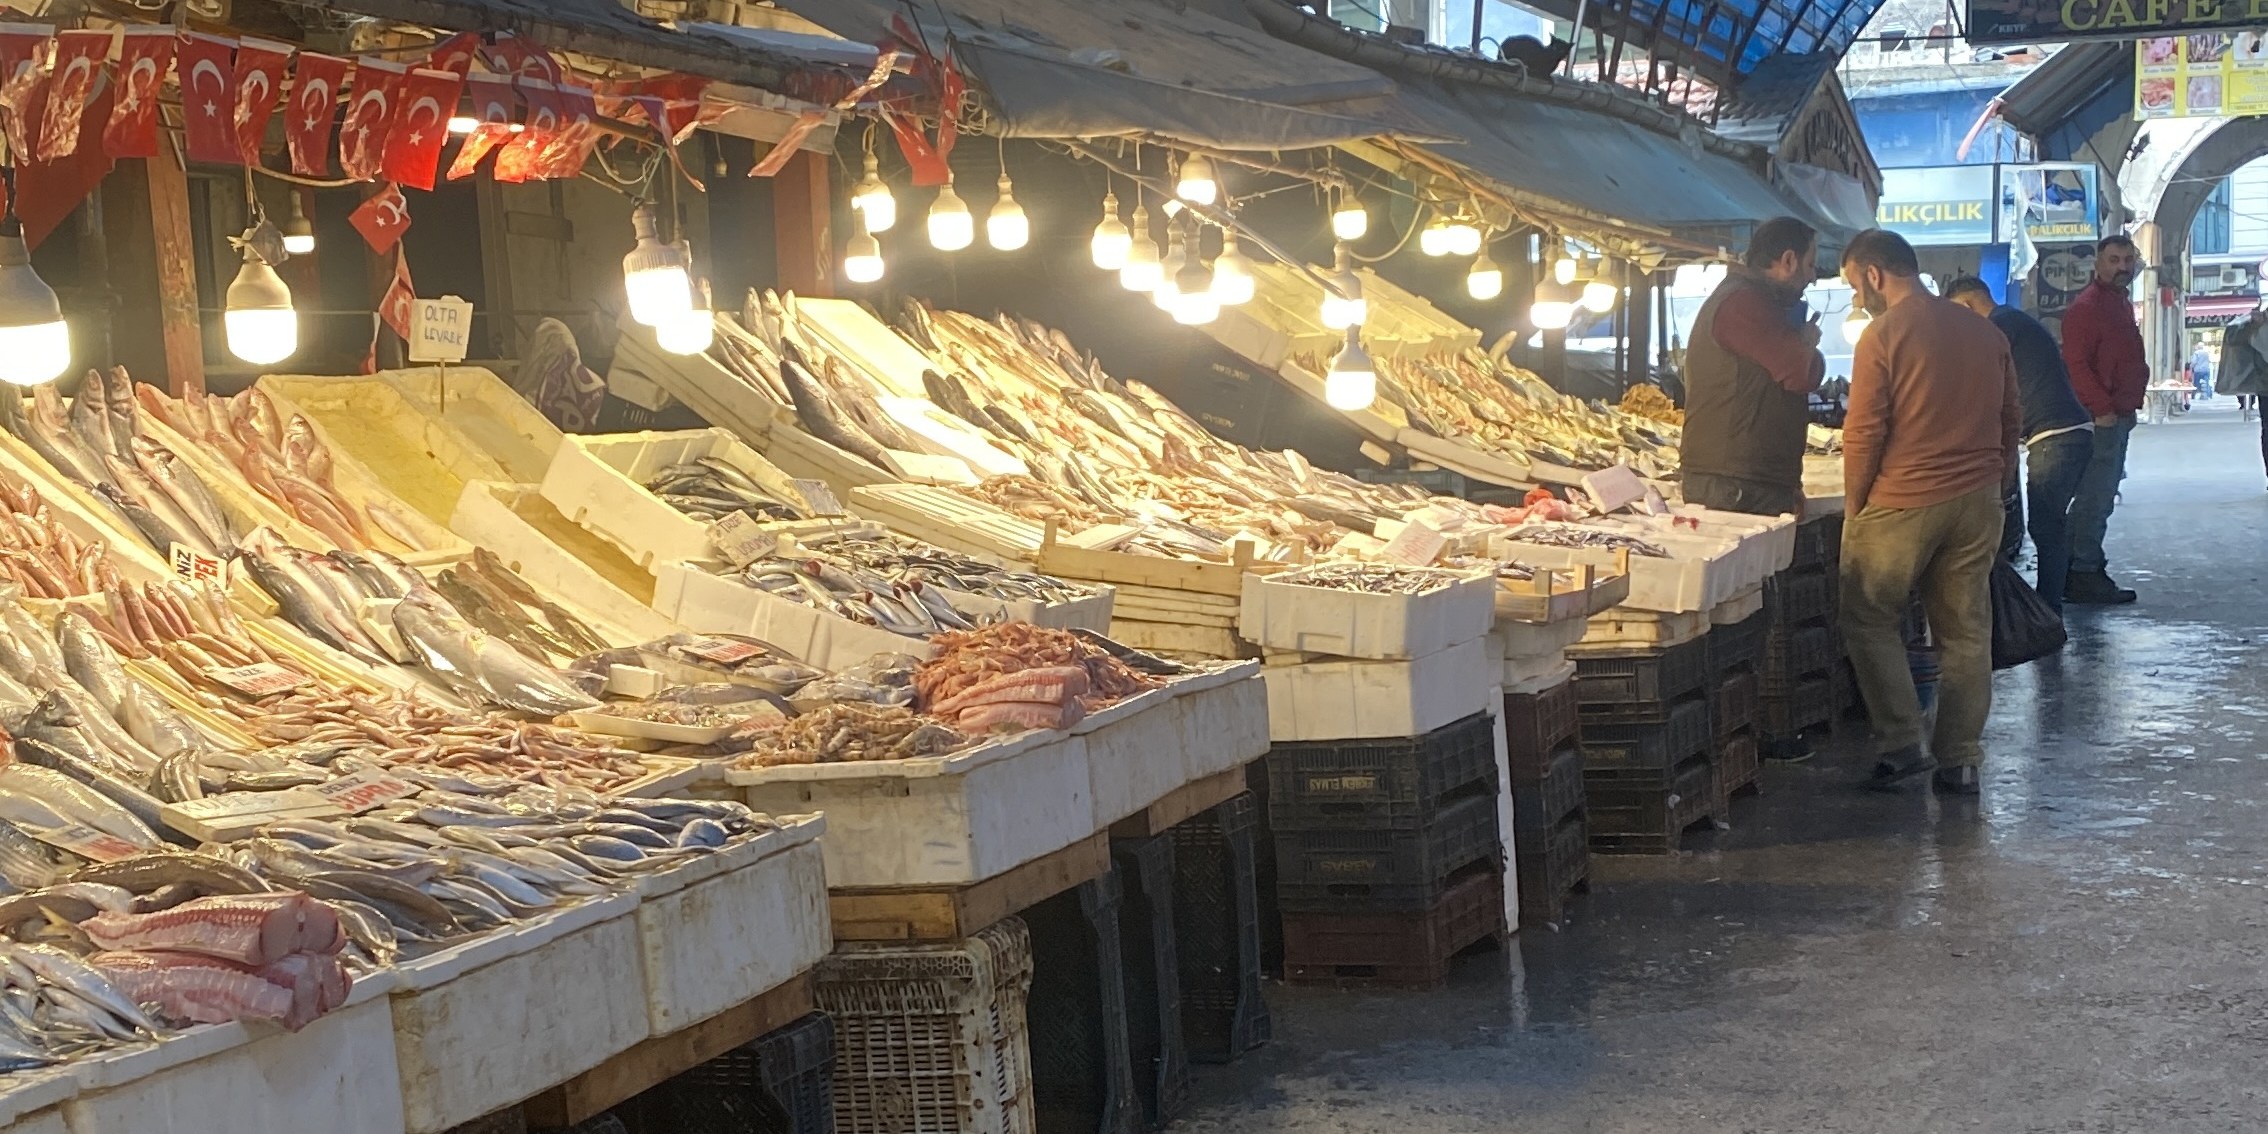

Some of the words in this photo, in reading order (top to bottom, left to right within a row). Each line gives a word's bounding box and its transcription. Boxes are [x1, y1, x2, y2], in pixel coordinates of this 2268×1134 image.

[2060, 0, 2222, 31] CAFE
[1876, 202, 1984, 225] LIKÇILIK
[425, 304, 458, 324] OLTA
[424, 326, 463, 346] LEVREK
